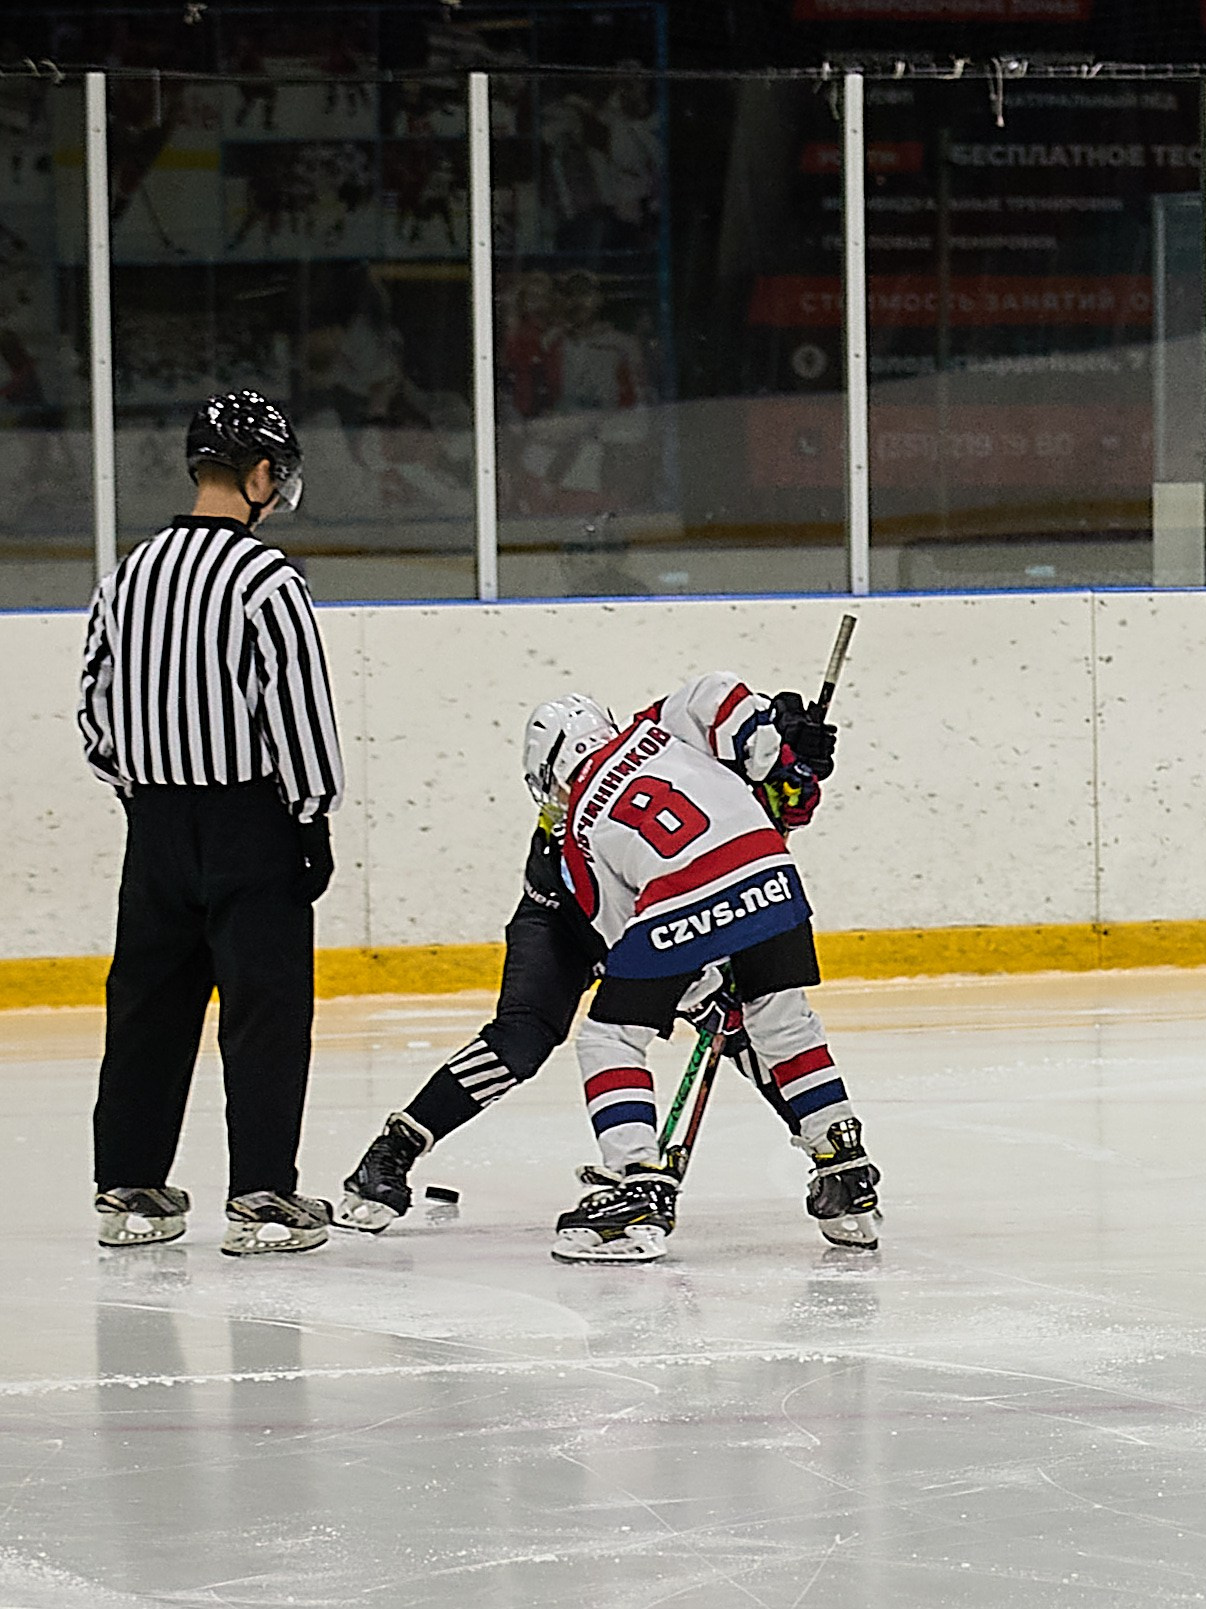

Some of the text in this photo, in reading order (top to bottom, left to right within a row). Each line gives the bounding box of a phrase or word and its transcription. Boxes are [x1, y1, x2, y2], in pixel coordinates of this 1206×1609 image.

[950, 143, 1144, 166] БЕСПЛАТНОЕ
[608, 775, 710, 860] 8
[650, 871, 793, 950] czvs.net
